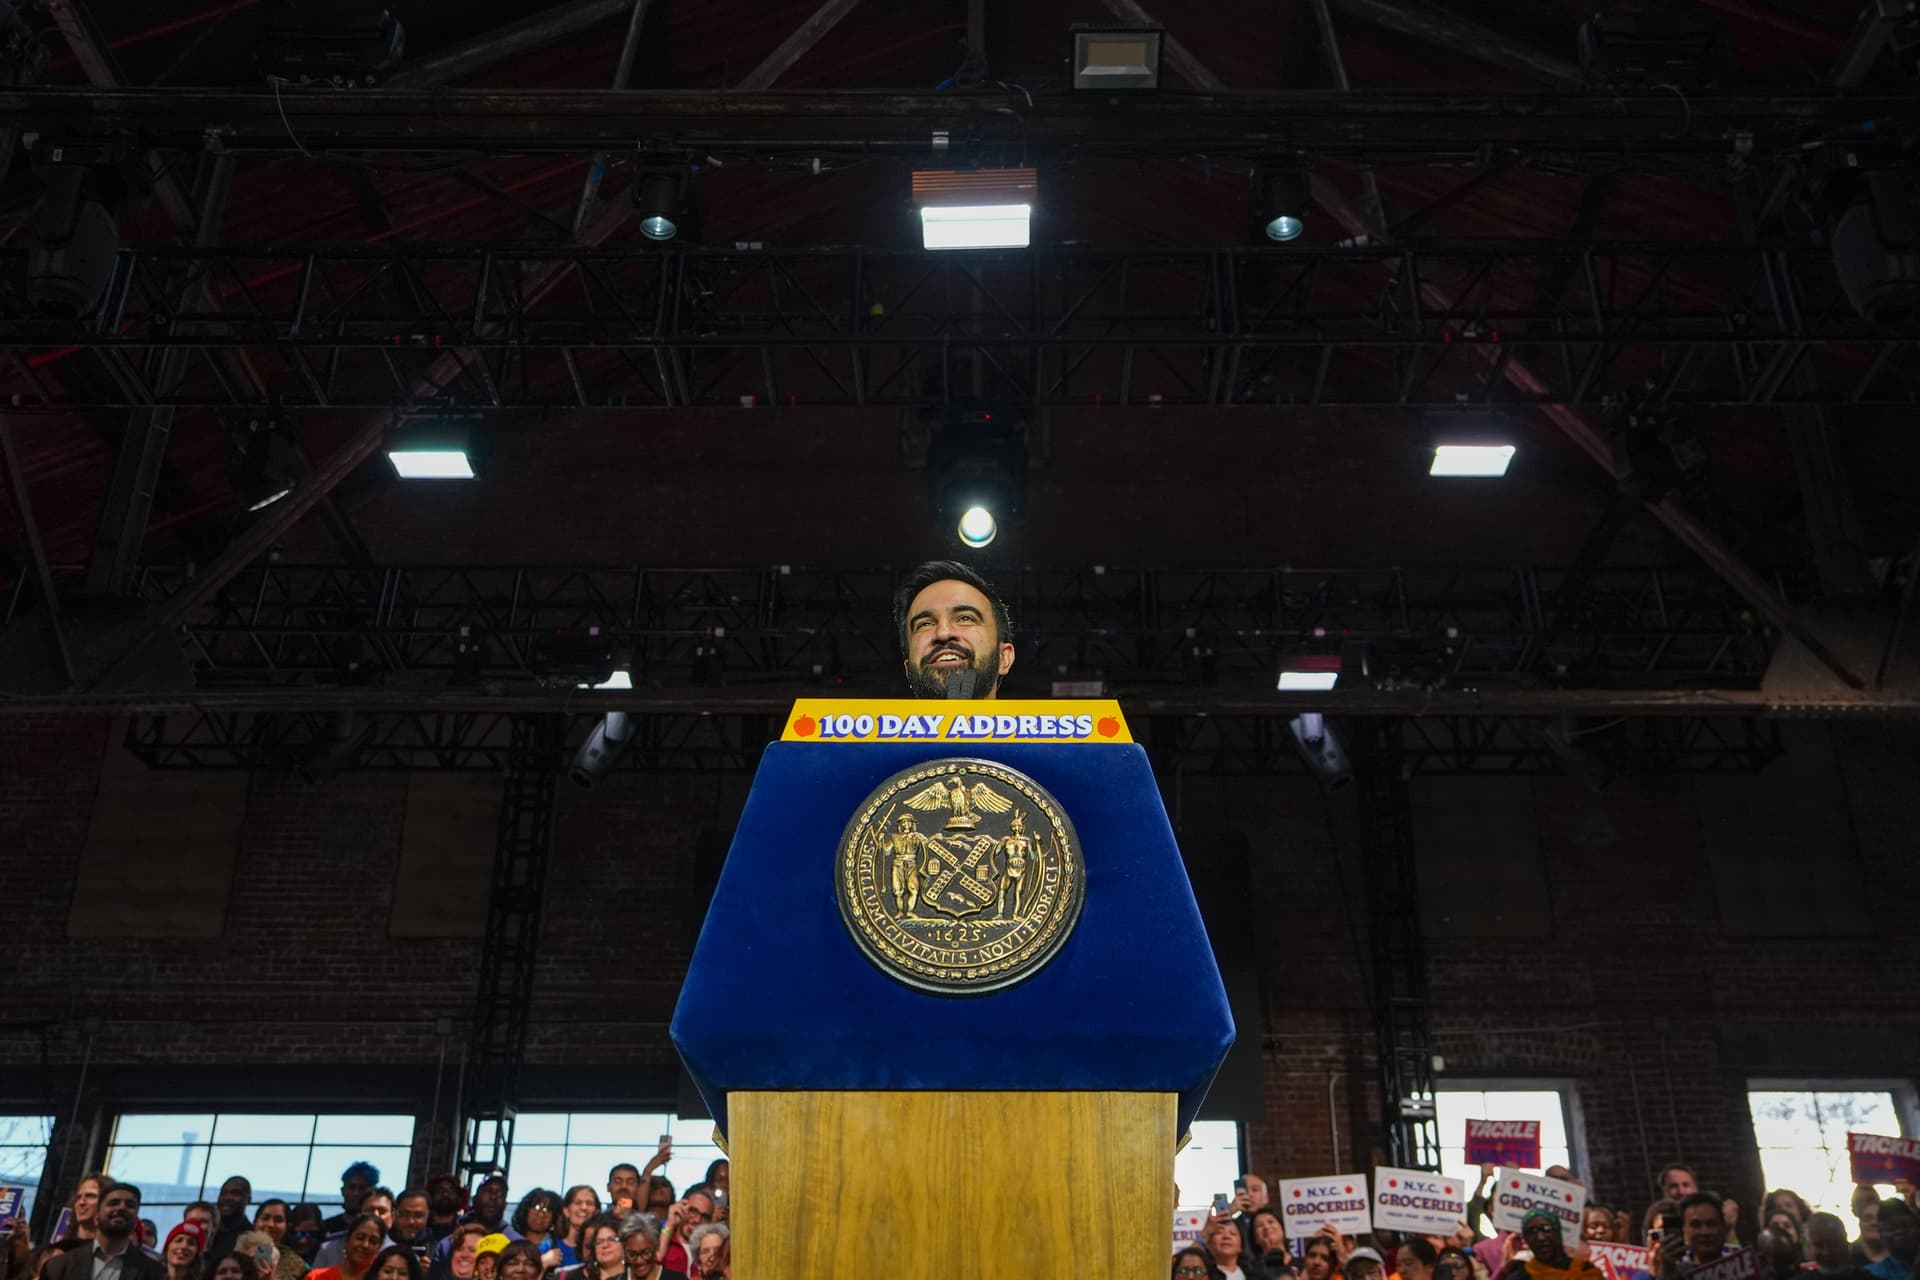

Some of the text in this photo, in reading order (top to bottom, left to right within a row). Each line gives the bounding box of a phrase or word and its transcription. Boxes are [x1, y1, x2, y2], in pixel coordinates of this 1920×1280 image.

[819, 713, 1094, 739] 100 DAY ADDRESS
[884, 922, 968, 964] CIVITATIS
[980, 932, 1023, 963] NOVI
[1027, 872, 1059, 934] EBORACI
[1471, 1121, 1537, 1138] TACKLE
[1307, 1187, 1341, 1197] N.Y.C.
[1404, 1180, 1440, 1193] N.Y.C.
[1526, 1183, 1560, 1200] N.Y.C.
[1286, 1199, 1366, 1216] GROCERIES
[1378, 1192, 1464, 1213] GROCERIES
[1590, 1245, 1649, 1270] TACKL
